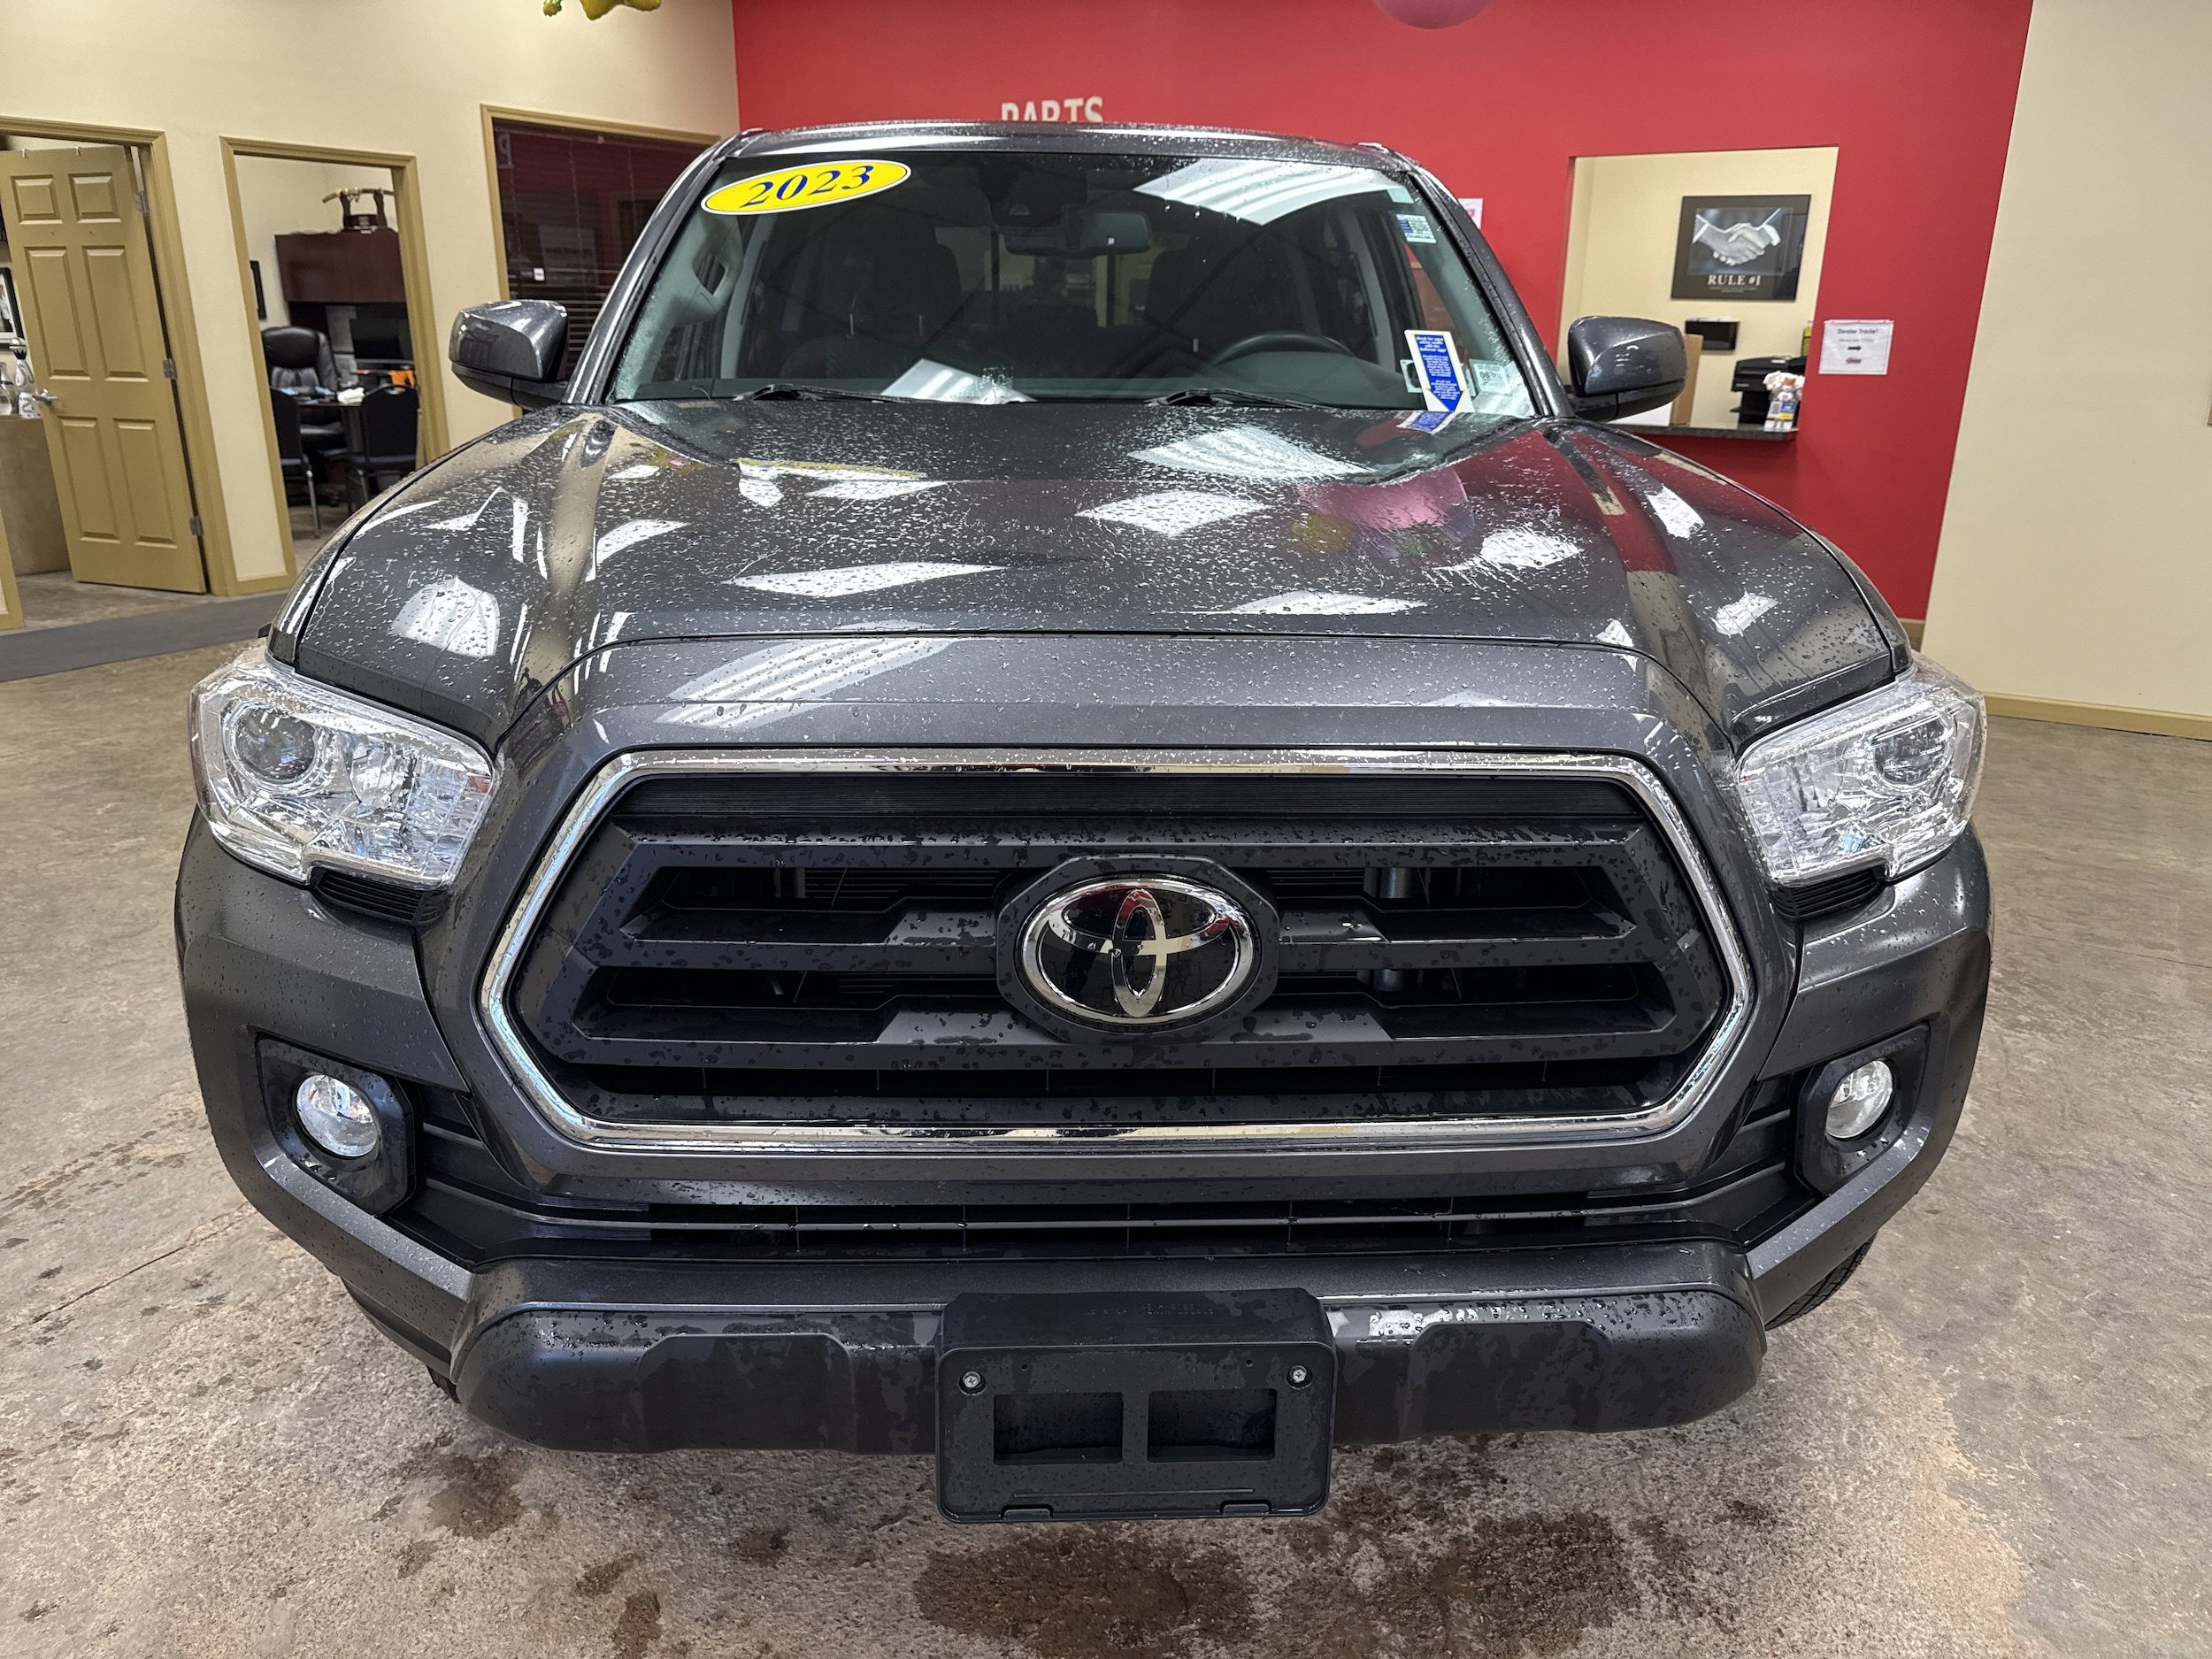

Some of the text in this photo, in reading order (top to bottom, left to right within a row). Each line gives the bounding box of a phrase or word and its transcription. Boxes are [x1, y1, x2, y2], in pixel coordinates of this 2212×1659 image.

[739, 165, 875, 208] 2023
[1707, 274, 1762, 286] RULE #1
